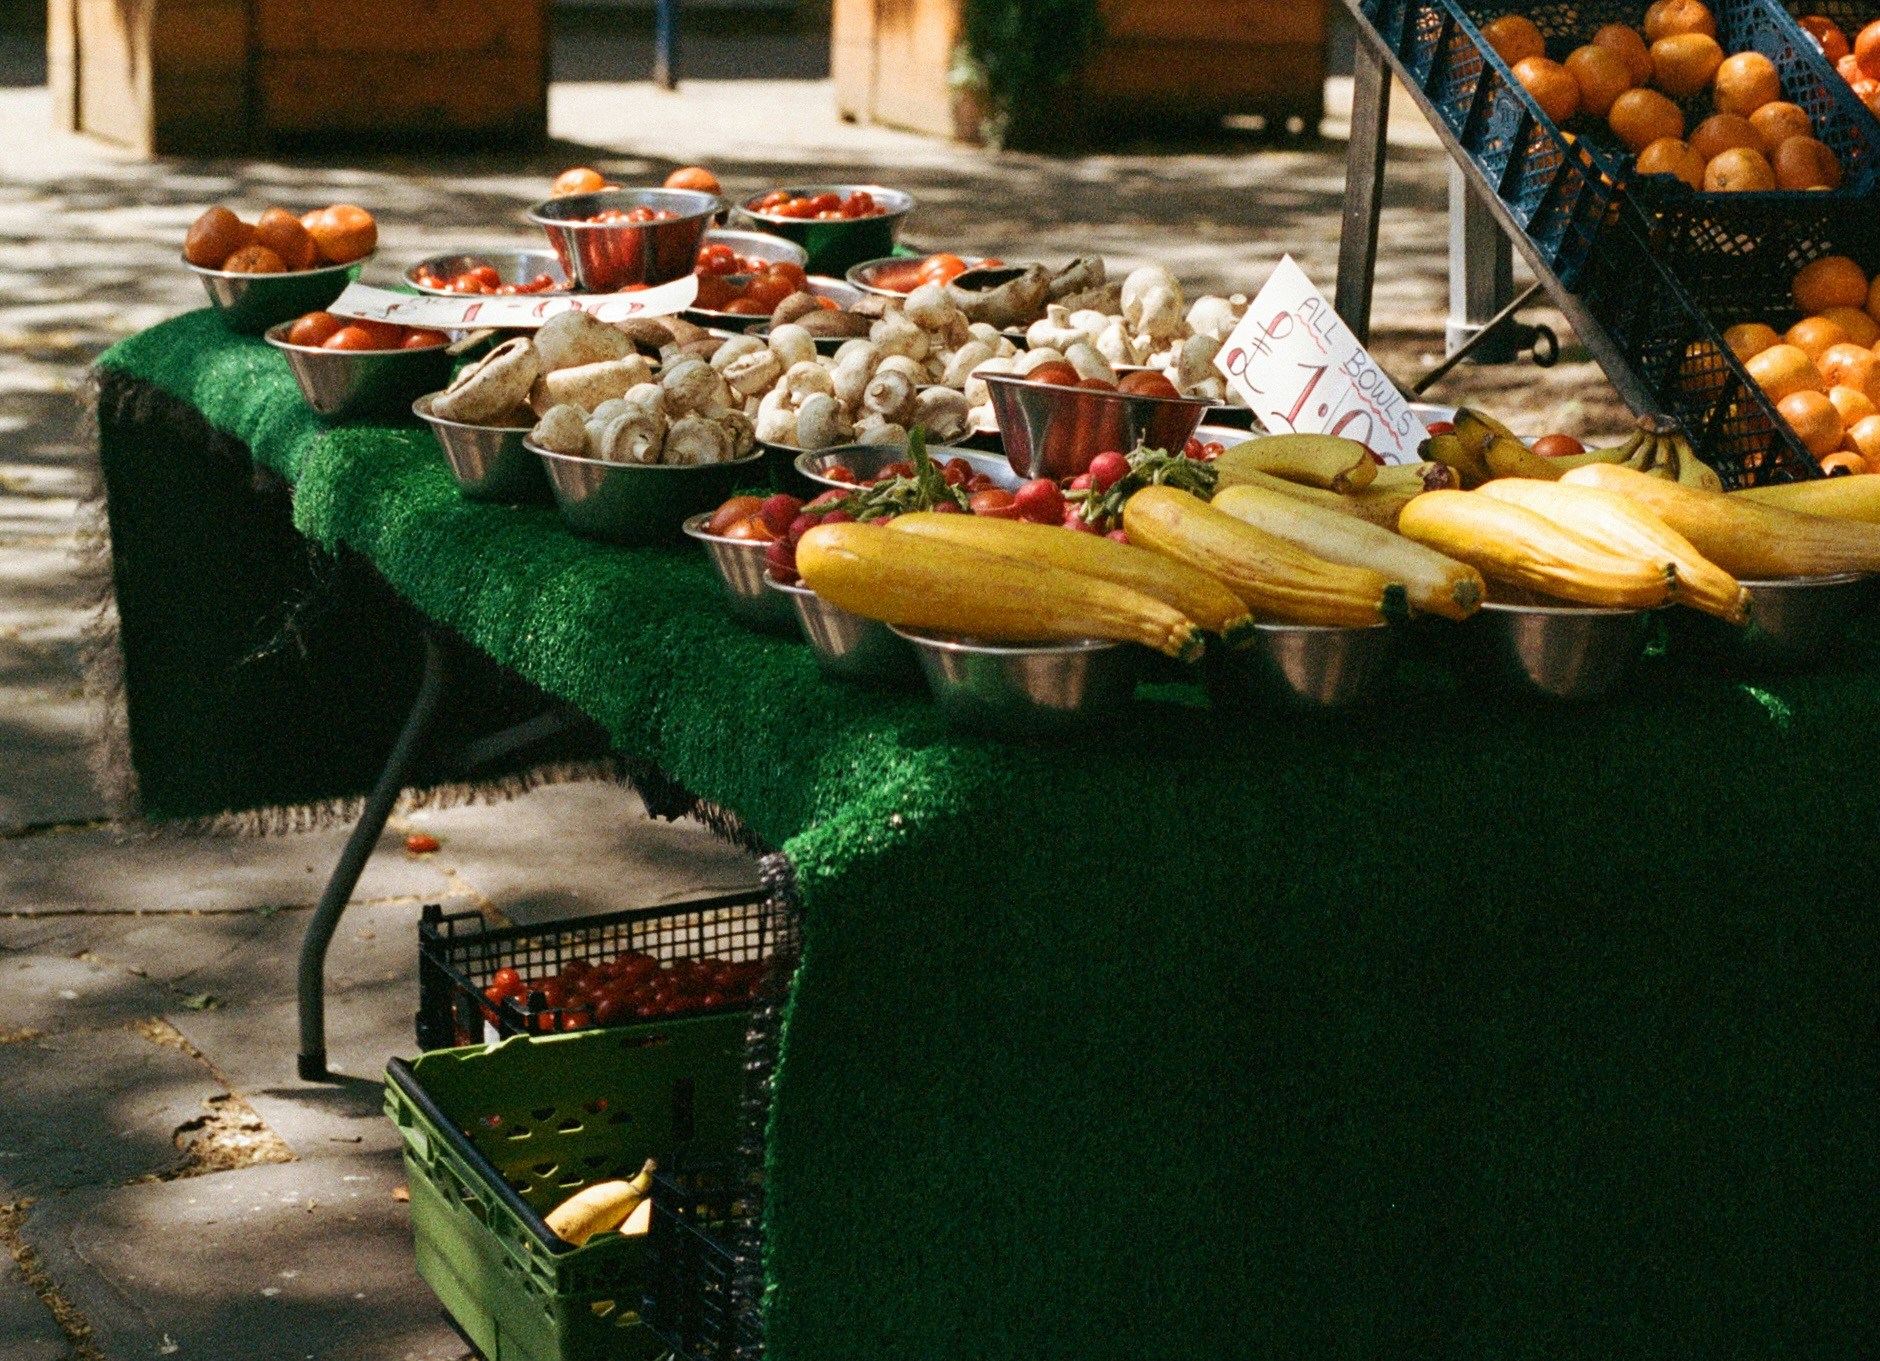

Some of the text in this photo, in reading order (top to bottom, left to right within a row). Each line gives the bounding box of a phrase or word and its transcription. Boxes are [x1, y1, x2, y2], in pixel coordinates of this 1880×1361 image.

[1226, 310, 1401, 465] £1.0
[1297, 296, 1414, 437] ALL BOWLS
